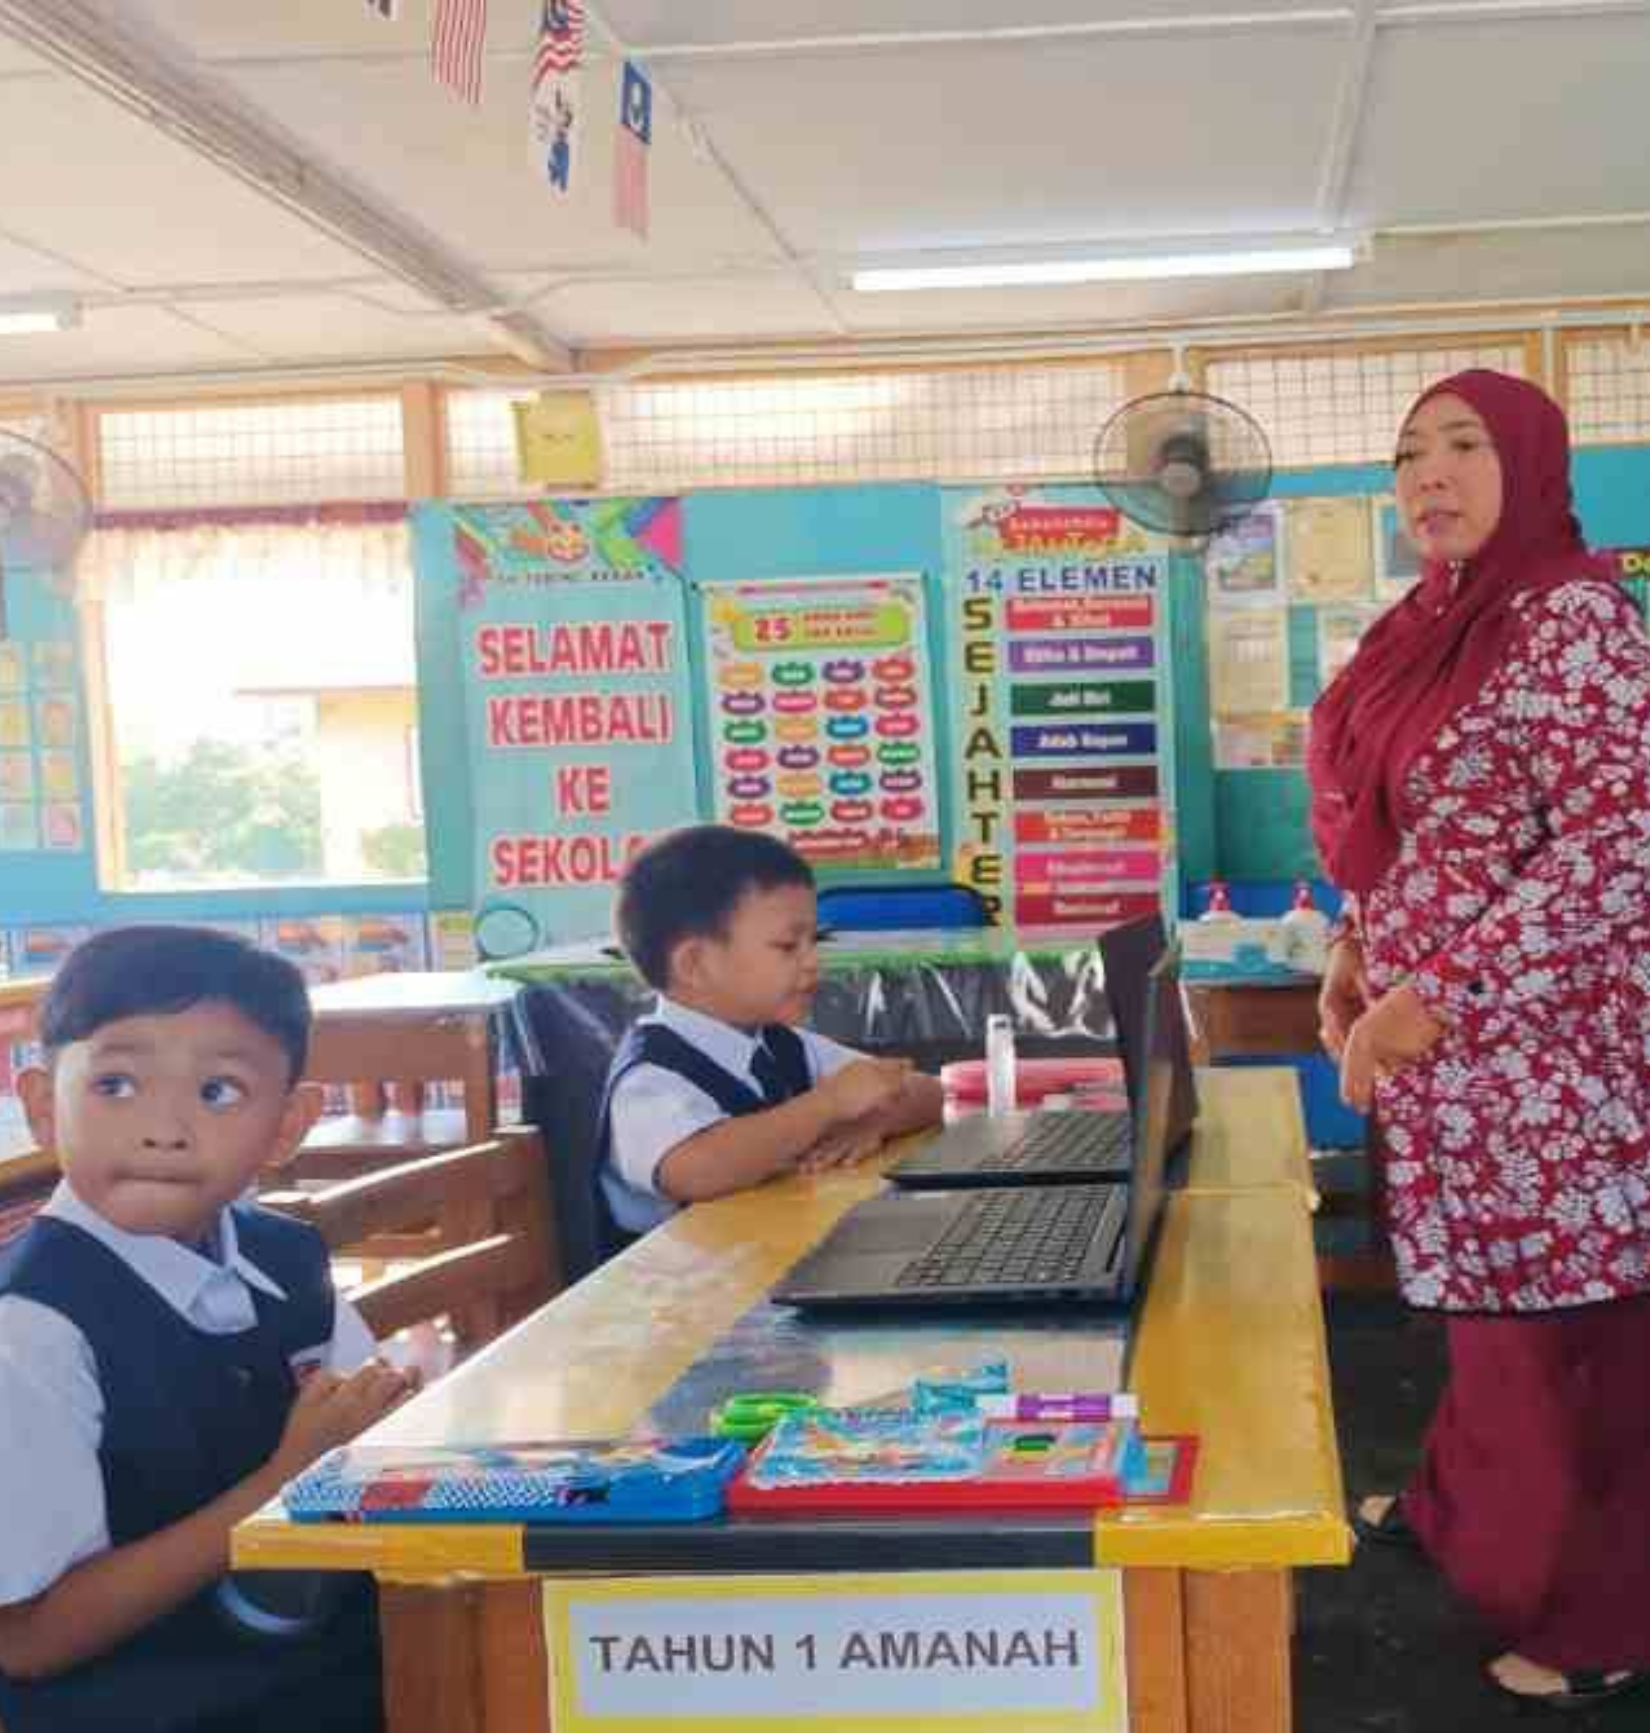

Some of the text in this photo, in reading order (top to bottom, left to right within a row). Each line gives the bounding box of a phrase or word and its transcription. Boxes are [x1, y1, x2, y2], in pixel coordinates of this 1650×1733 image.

[1018, 565, 1156, 592] ELEMEN
[477, 622, 671, 676] SELAMAT
[488, 692, 672, 746] KEMBALI
[557, 765, 611, 814] KE
[588, 1629, 1080, 1673] TAHUN 1 AMANAH
